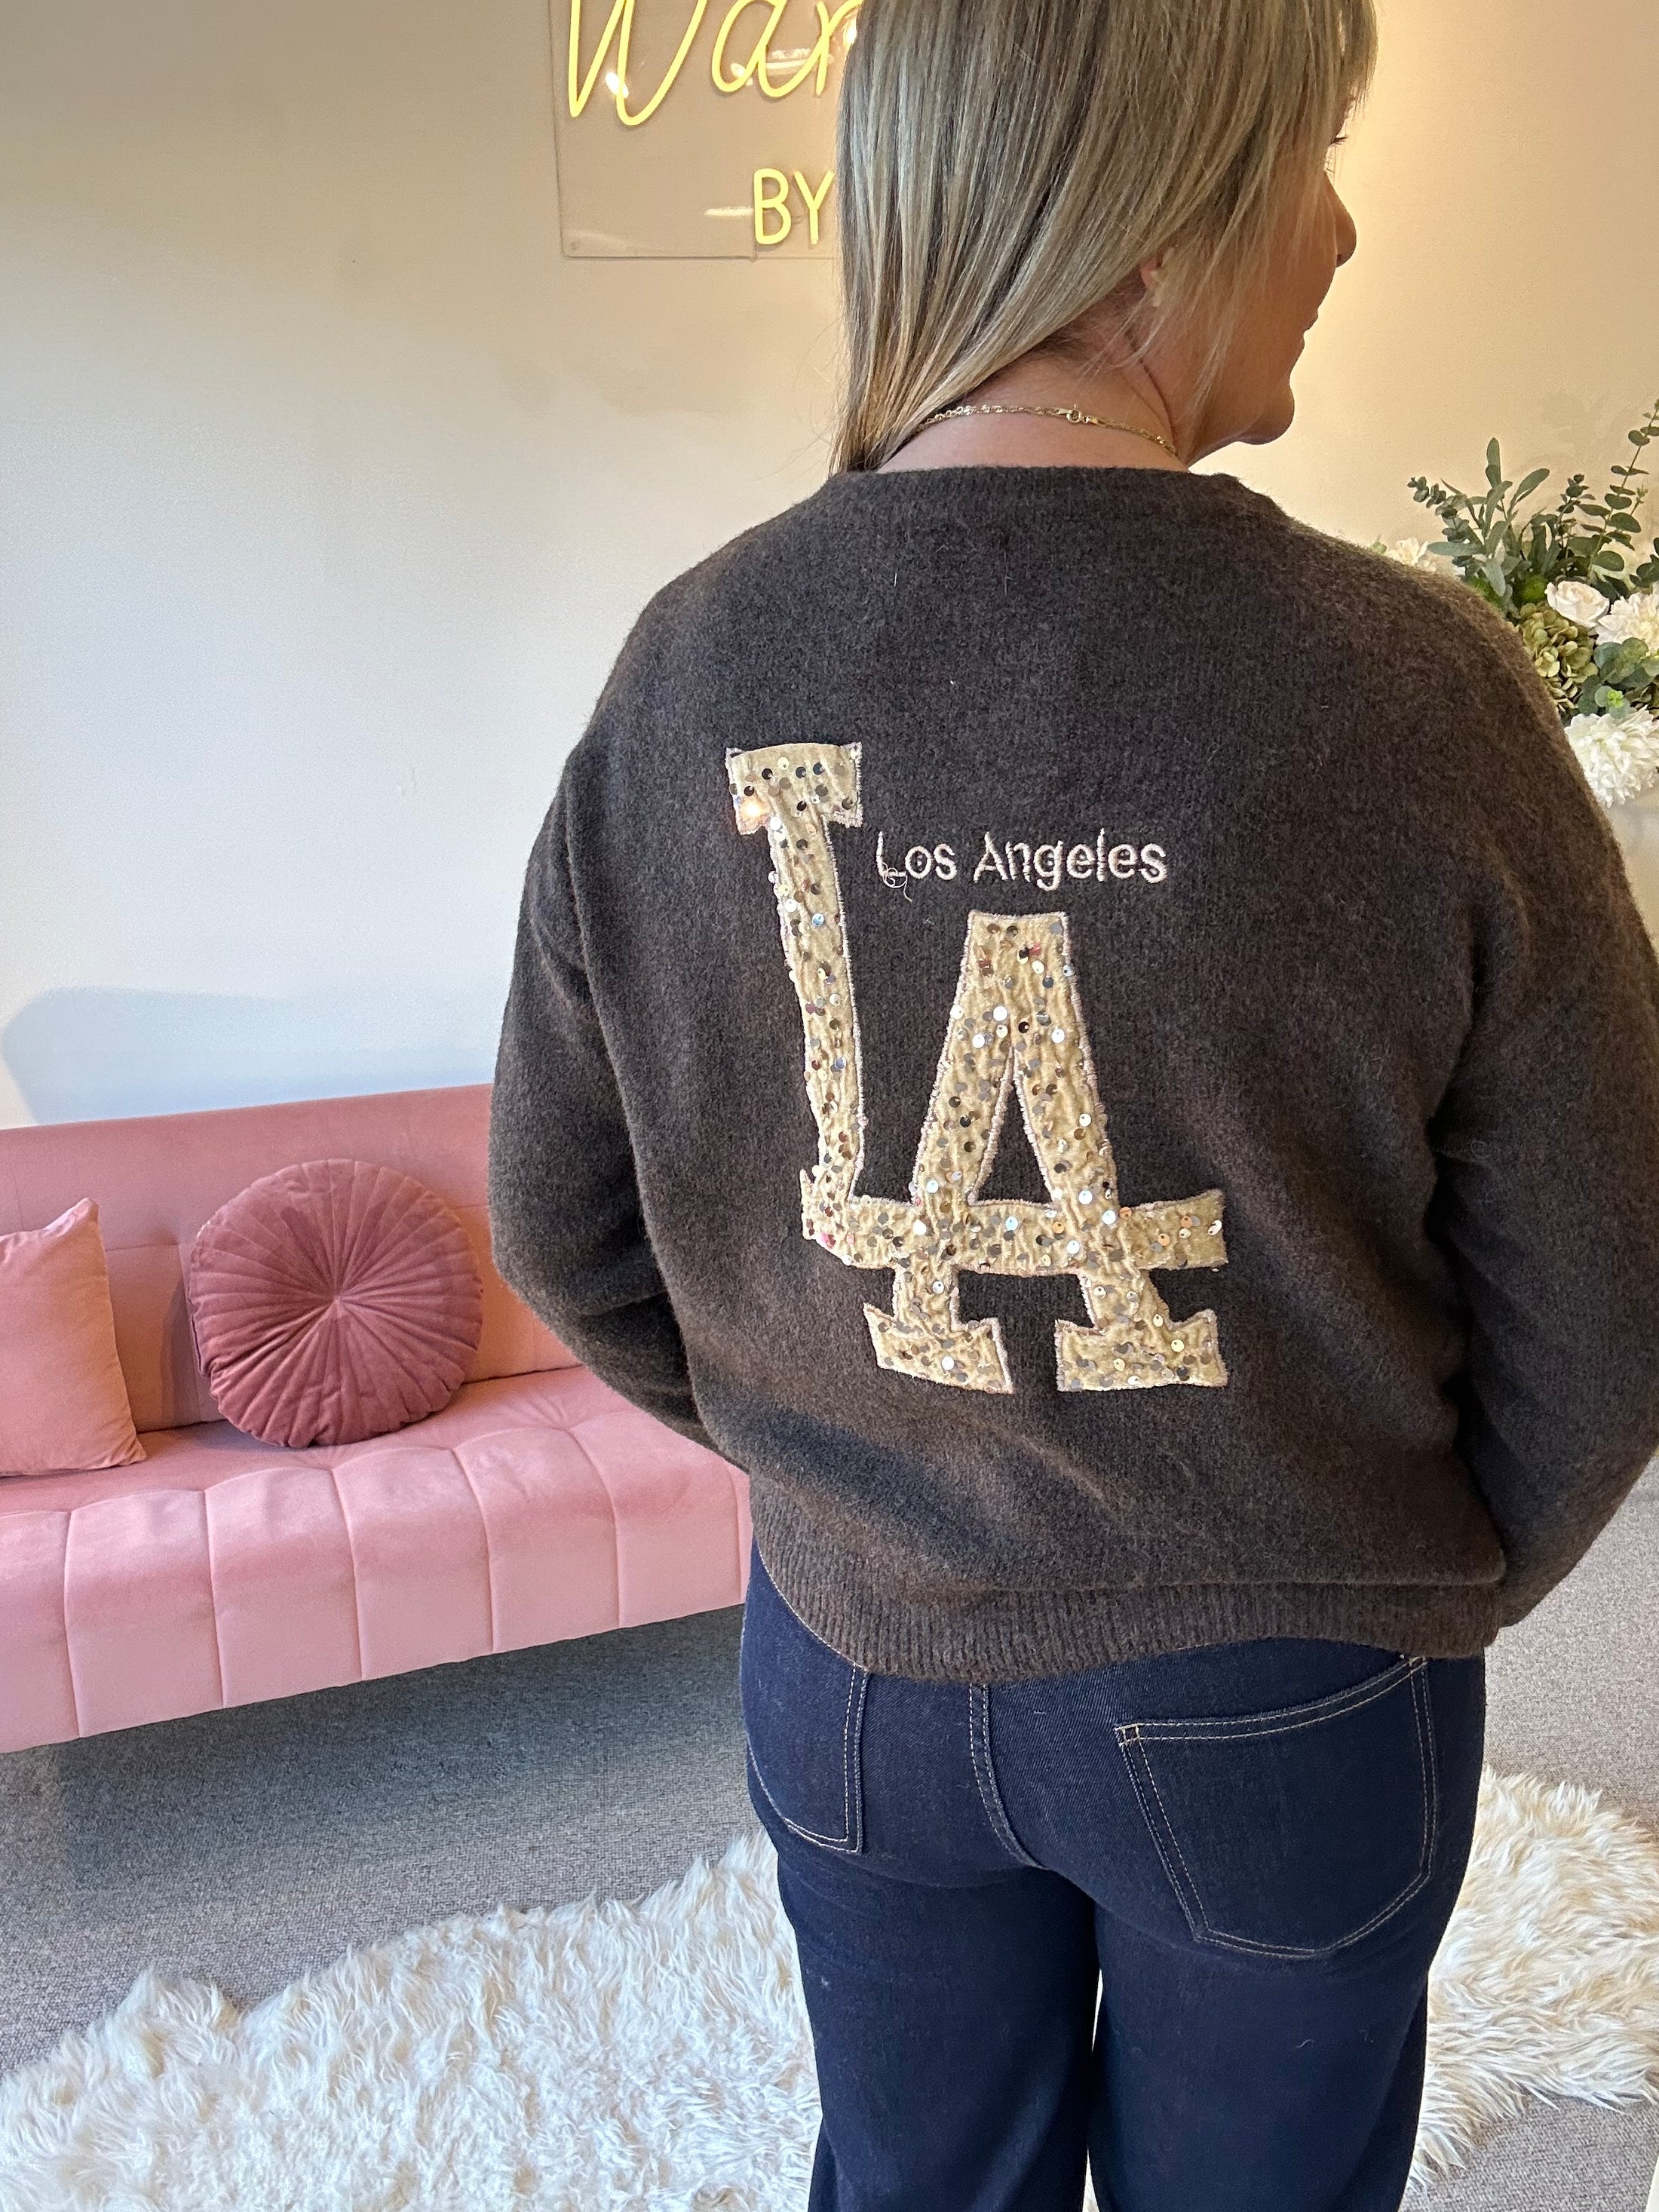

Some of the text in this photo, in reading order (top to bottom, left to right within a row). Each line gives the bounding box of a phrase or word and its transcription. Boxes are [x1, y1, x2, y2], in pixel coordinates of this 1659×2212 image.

[753, 168, 834, 245] BY
[875, 828, 1167, 891] Los Angeles
[726, 741, 1228, 1394] LA
